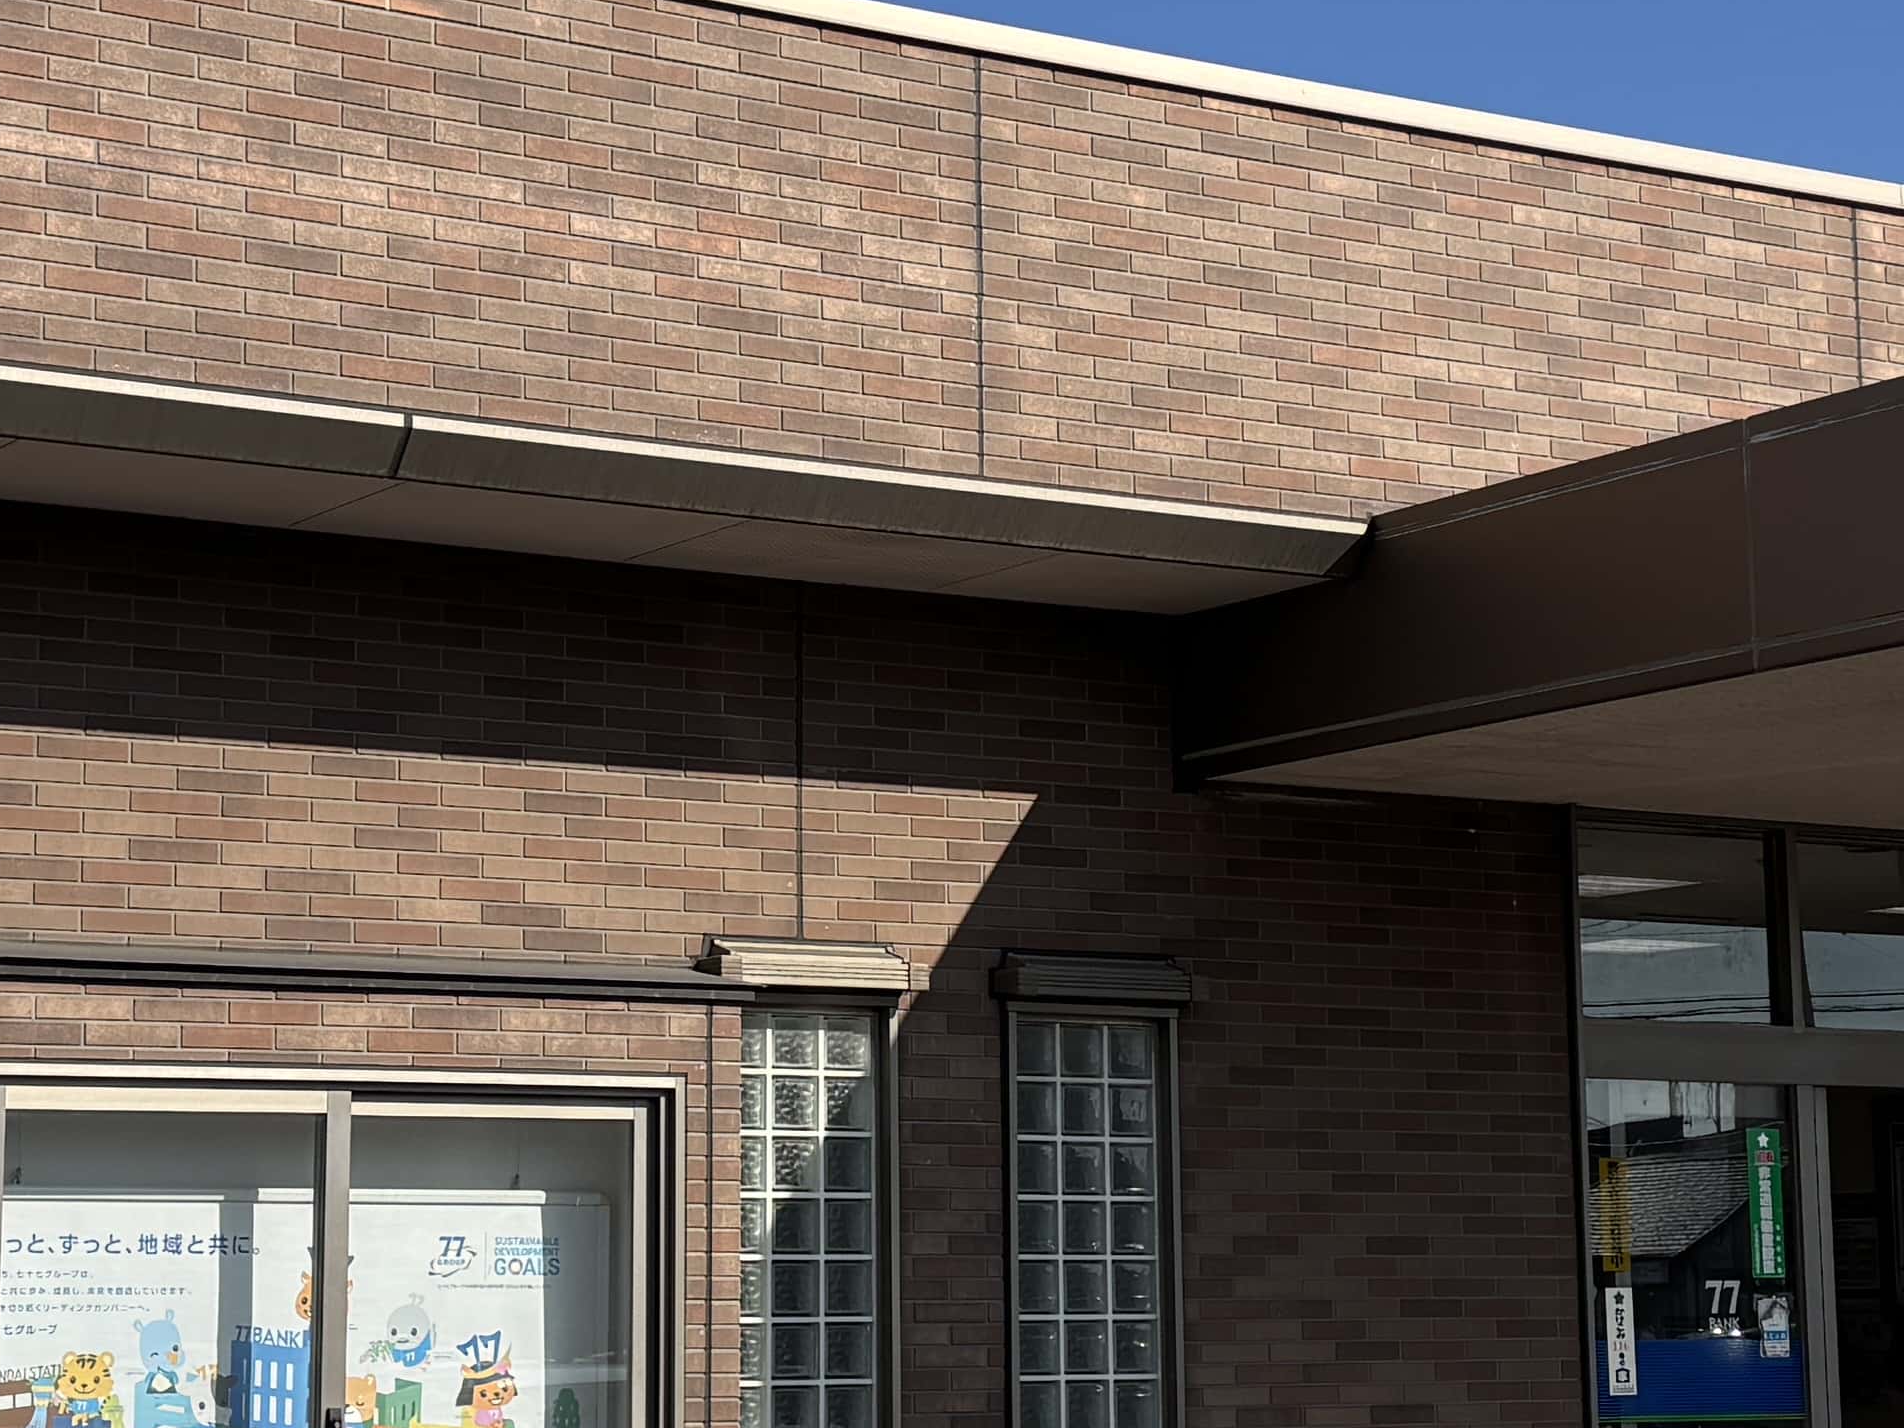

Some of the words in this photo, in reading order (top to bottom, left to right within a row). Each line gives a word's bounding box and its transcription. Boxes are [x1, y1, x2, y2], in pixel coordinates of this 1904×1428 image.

[6, 1233, 264, 1256] っと、ずっと、地域と共に。
[439, 1236, 466, 1257] 77
[494, 1248, 560, 1257] DEVELOPMENT
[494, 1258, 561, 1276] GOALS
[1704, 1280, 1741, 1314] 77
[4, 1324, 57, 1336] 七グループ
[1709, 1317, 1741, 1332] BANK
